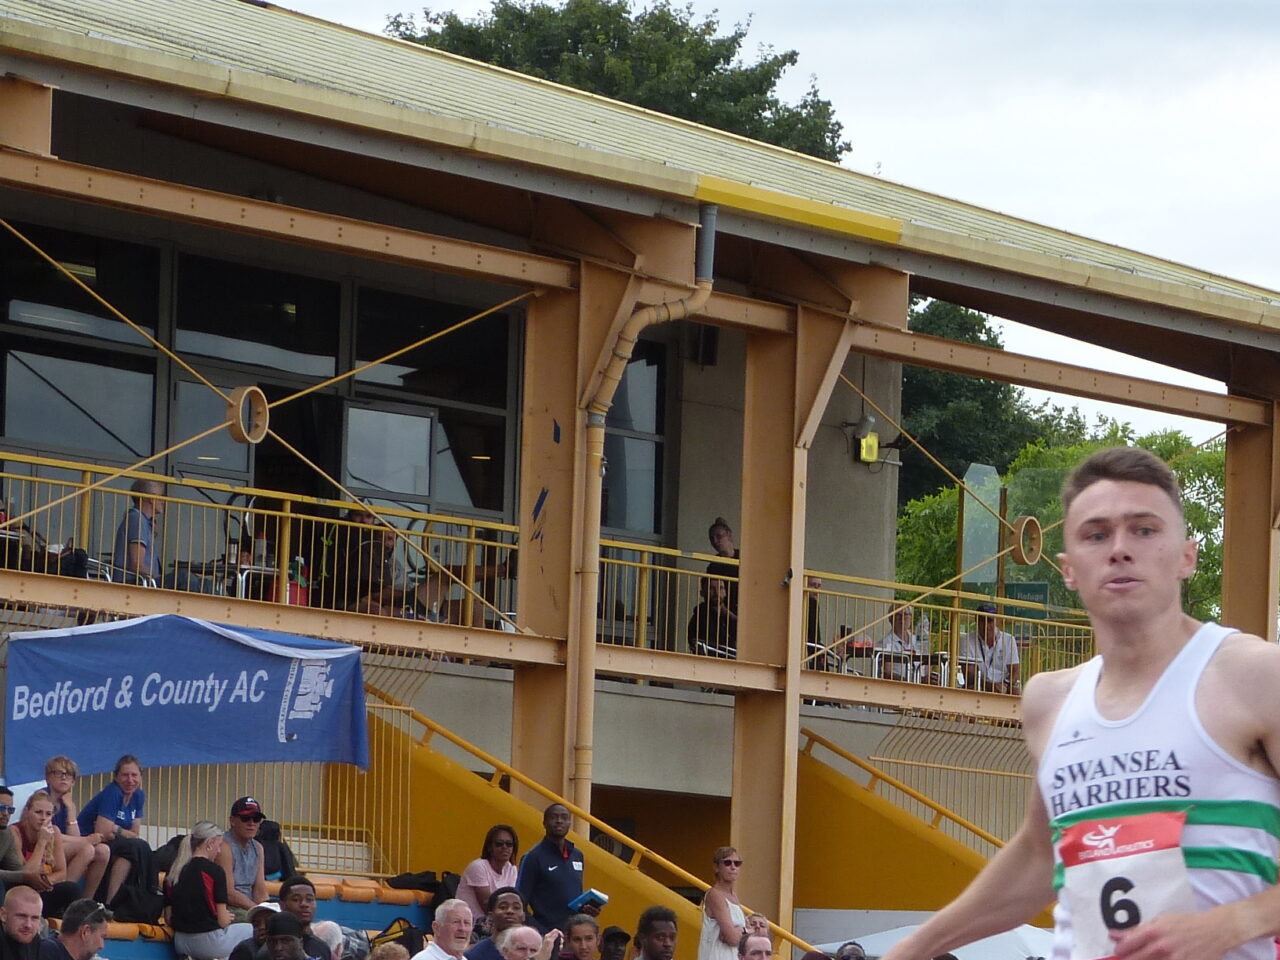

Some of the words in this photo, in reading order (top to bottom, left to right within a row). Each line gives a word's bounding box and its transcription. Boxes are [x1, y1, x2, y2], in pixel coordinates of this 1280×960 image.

[12, 677, 112, 721] Bedford
[114, 675, 133, 709] &
[141, 671, 229, 712] County
[230, 669, 269, 703] AC
[1053, 749, 1183, 790] SWANSEA
[1050, 775, 1191, 817] HARRIERS
[1100, 876, 1141, 930] 6
